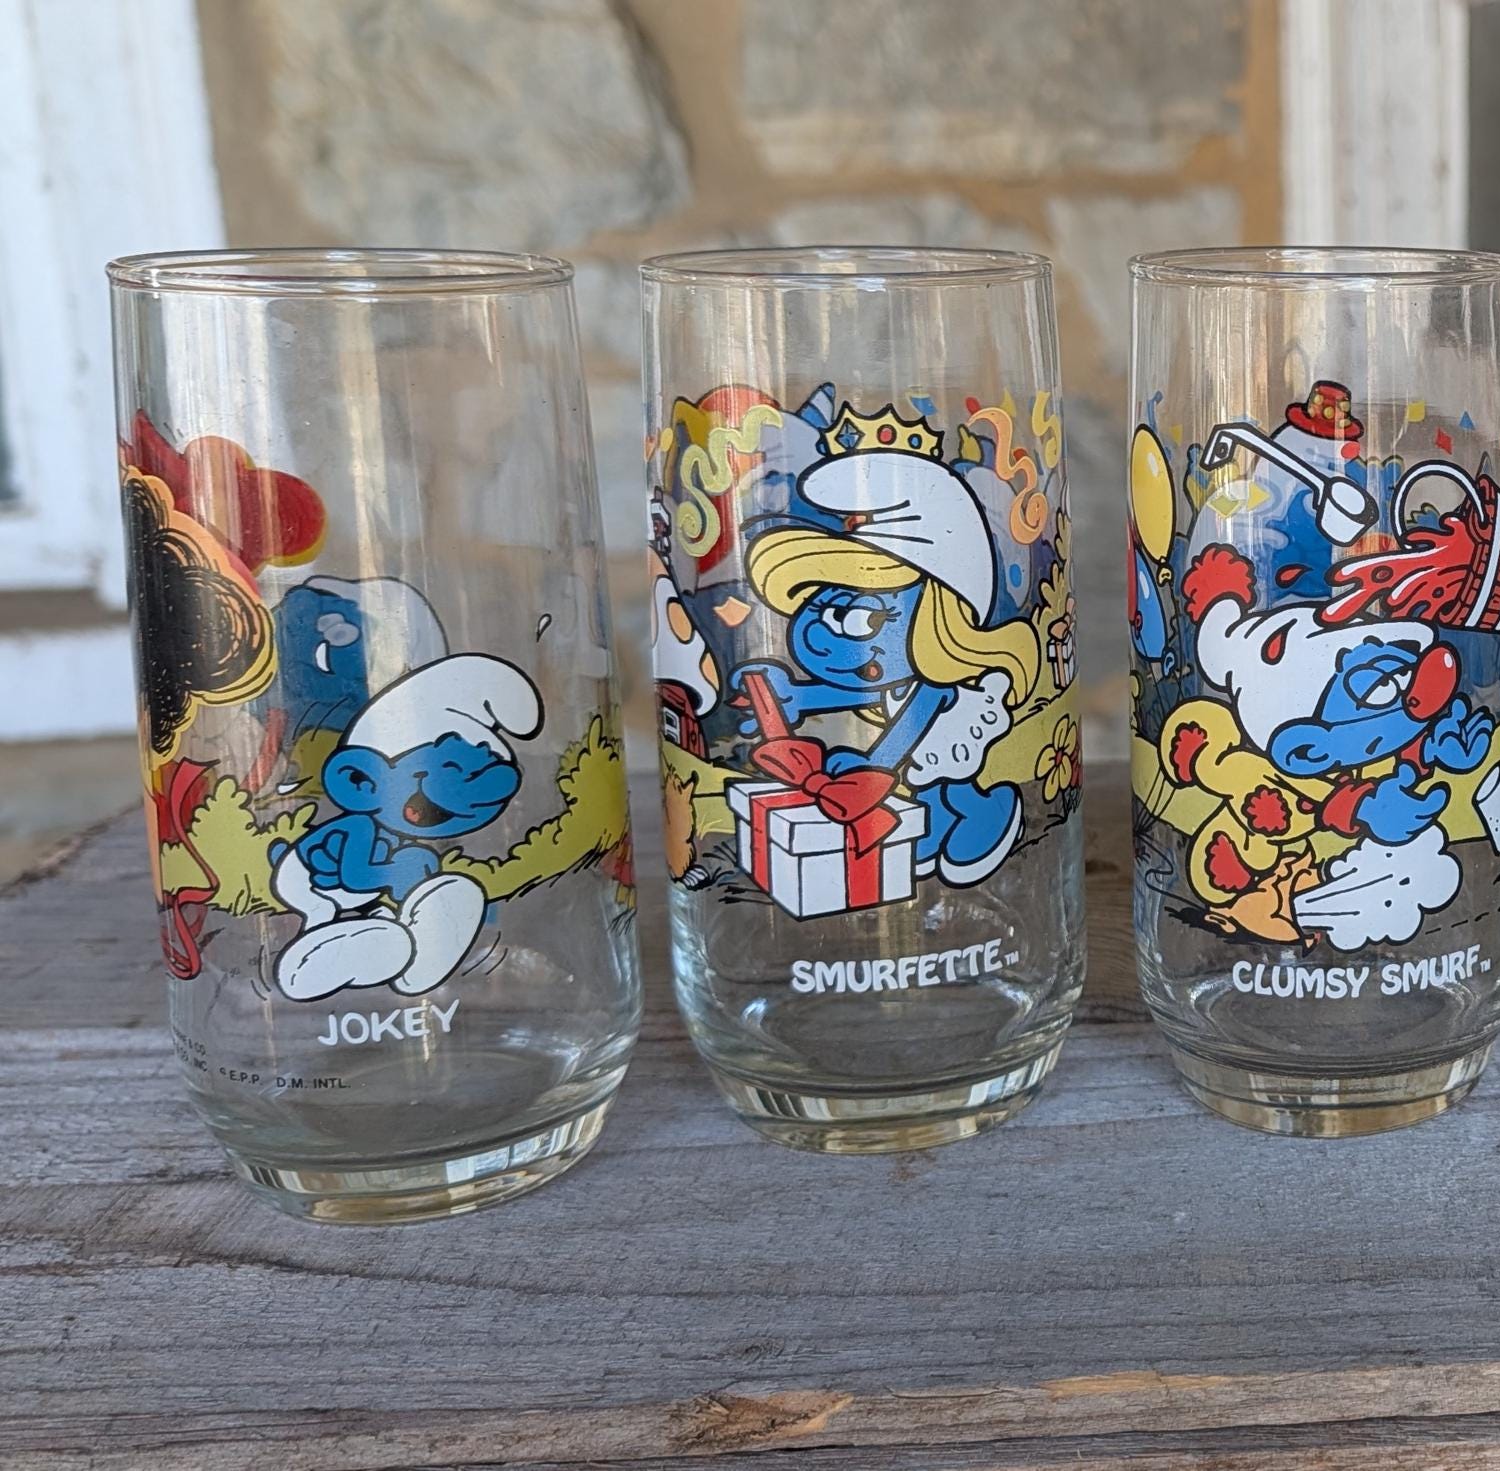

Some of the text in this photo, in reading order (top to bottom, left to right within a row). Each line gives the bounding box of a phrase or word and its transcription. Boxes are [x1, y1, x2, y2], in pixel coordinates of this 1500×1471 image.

[791, 938, 1004, 995] SMURFETTE
[1232, 960, 1371, 999] CLUMSY
[1380, 944, 1480, 996] SMURF
[318, 999, 460, 1047] JOKEY
[276, 1077, 308, 1089] D.M.
[313, 1078, 351, 1089] INTL.
